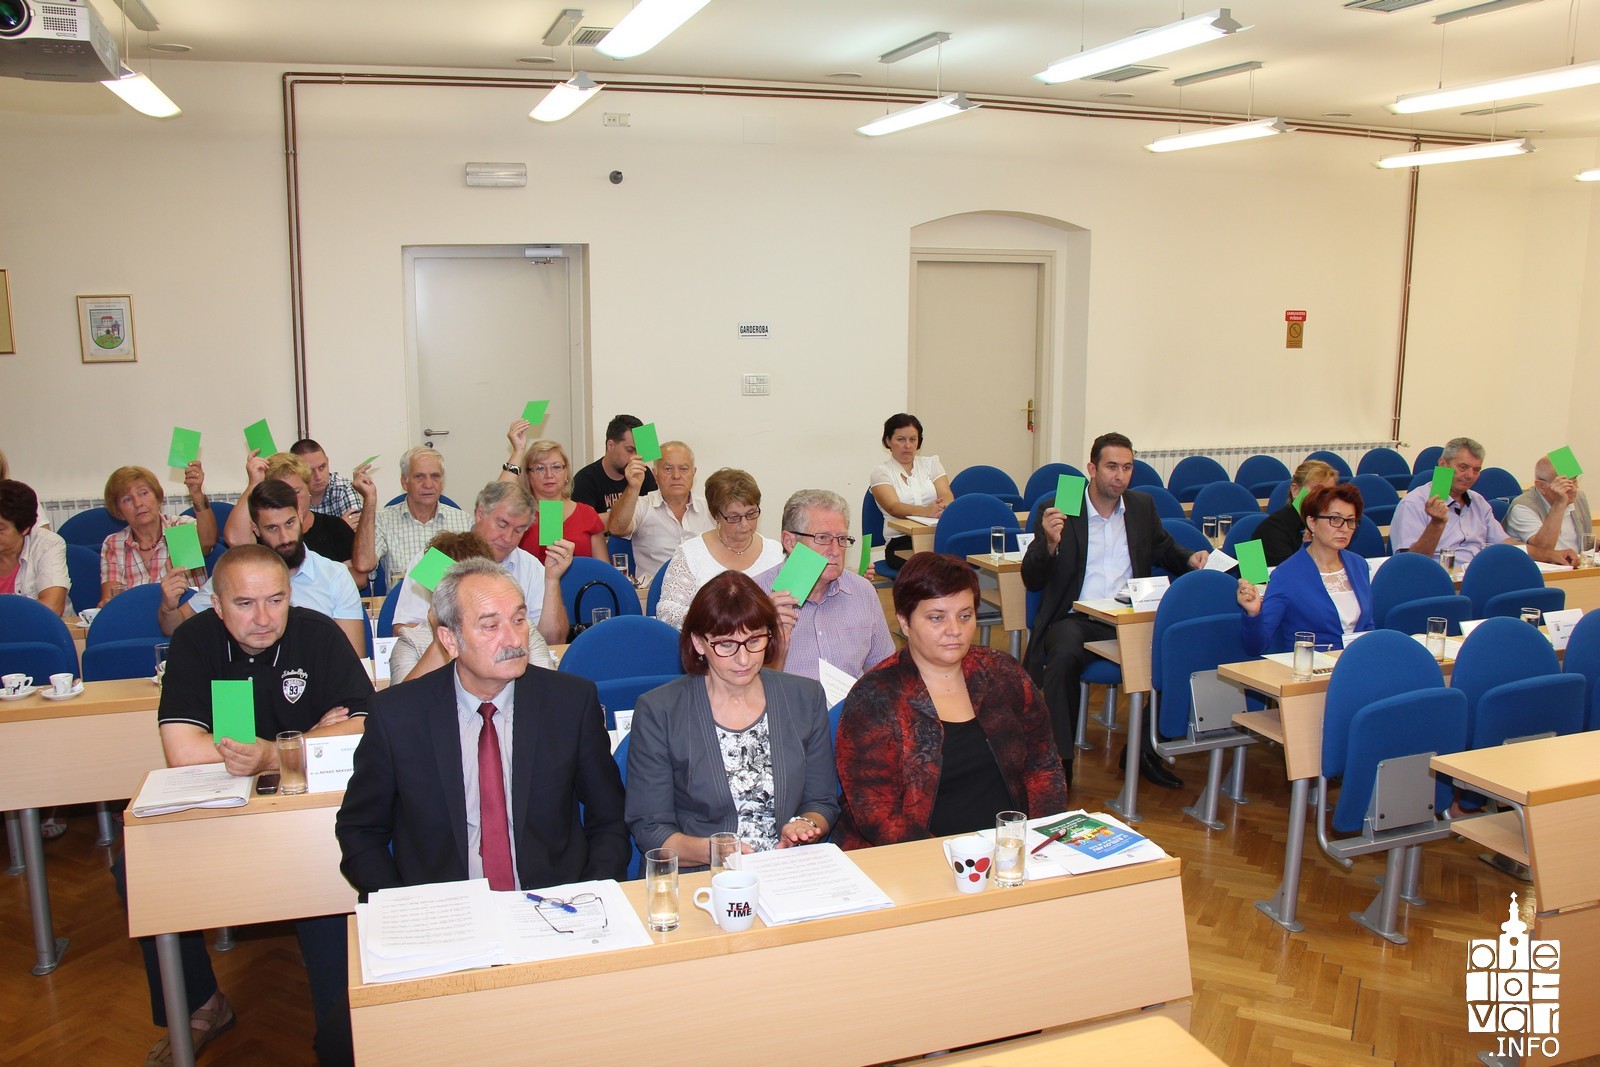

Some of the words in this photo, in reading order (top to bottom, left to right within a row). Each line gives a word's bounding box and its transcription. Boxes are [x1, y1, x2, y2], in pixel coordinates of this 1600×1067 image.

[739, 325, 769, 334] GARDEROBA
[289, 685, 299, 696] 93
[728, 901, 750, 912] TEA
[726, 908, 752, 918] TIME
